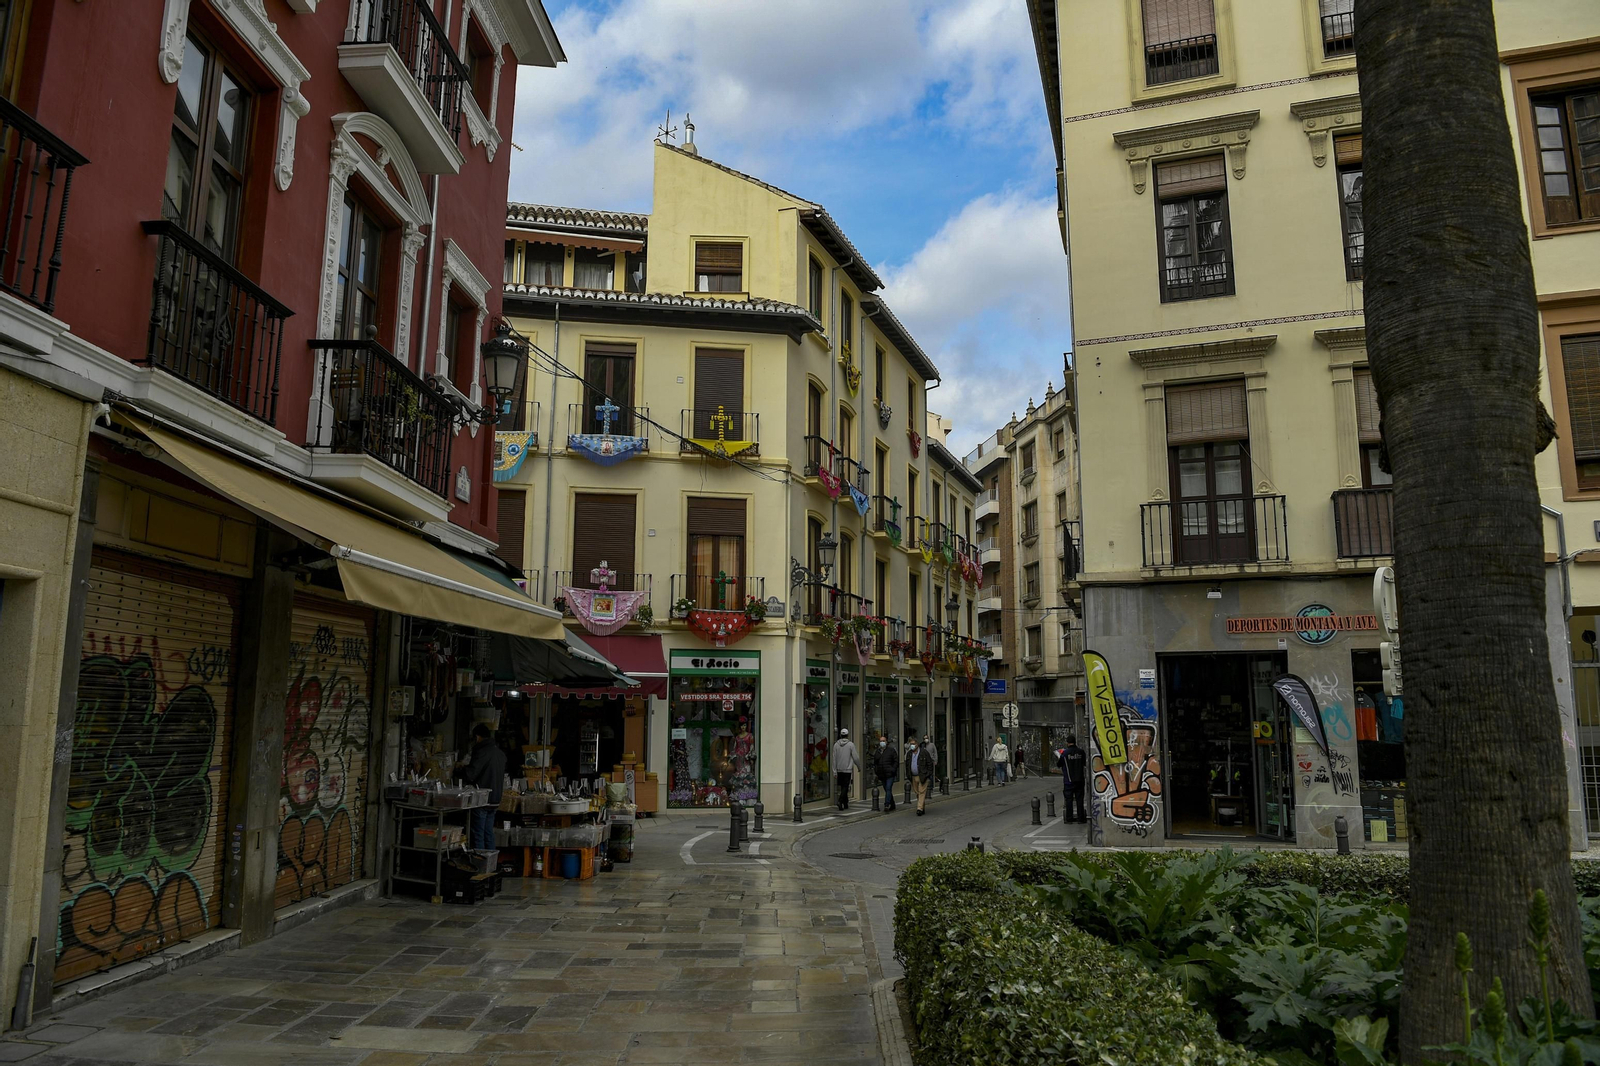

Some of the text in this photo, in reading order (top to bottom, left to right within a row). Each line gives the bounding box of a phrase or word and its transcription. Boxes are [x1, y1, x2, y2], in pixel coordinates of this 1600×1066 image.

[1227, 618, 1279, 633] DEPORTES
[1280, 617, 1294, 632] DE
[1295, 612, 1343, 631] MONTAÑA
[1345, 616, 1353, 630] Y
[691, 658, 703, 667] El
[1095, 675, 1122, 758] BOREAL
